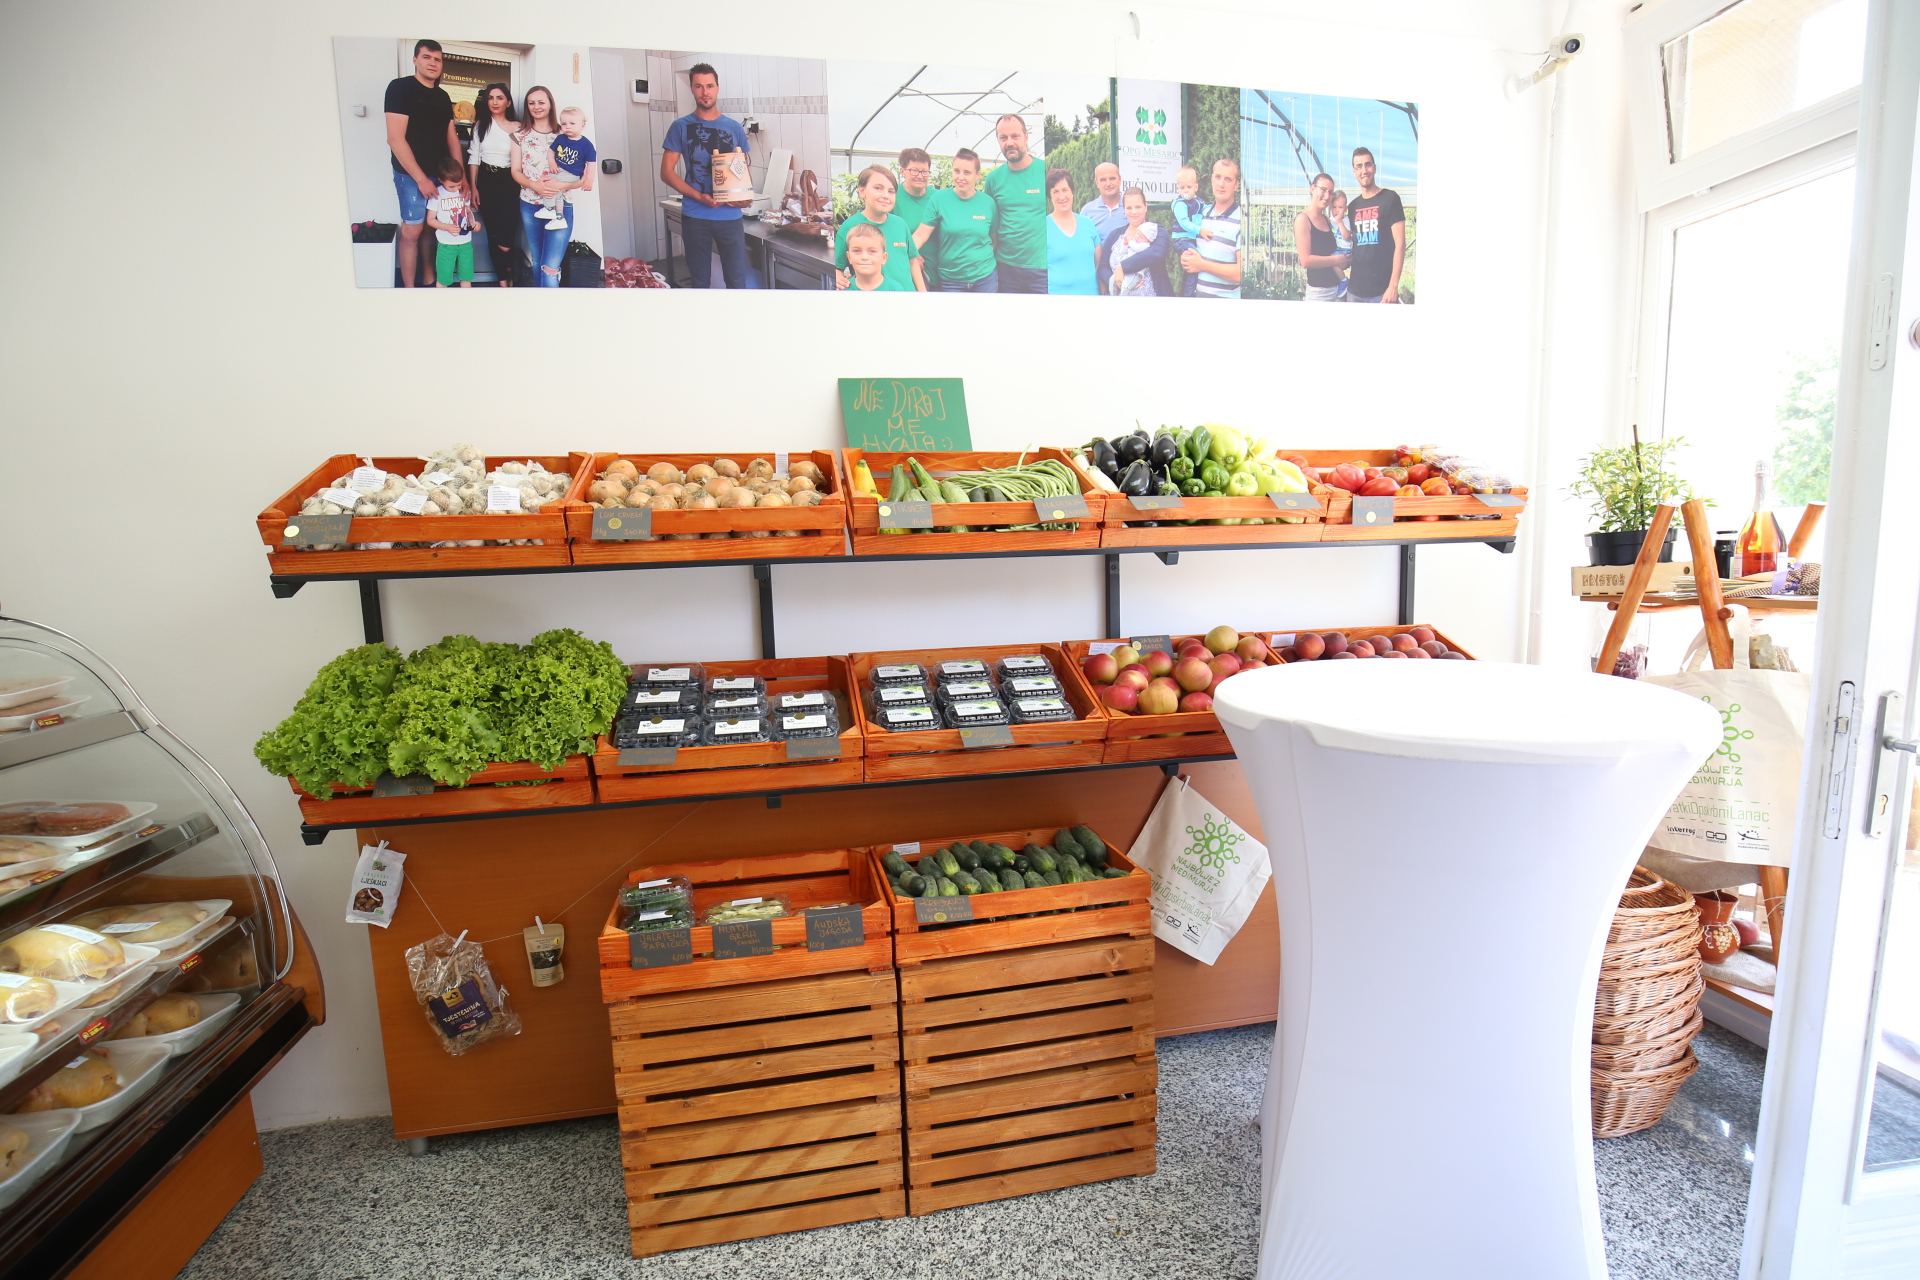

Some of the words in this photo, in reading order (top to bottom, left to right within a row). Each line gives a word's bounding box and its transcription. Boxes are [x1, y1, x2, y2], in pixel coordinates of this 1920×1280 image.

[443, 72, 472, 82] Promess
[1355, 207, 1379, 221] AMS
[1355, 219, 1379, 233] TER
[1356, 231, 1379, 244] DAM
[853, 380, 884, 412] NE
[887, 415, 926, 437] ME
[1170, 863, 1214, 895] MEĐIMURJA
